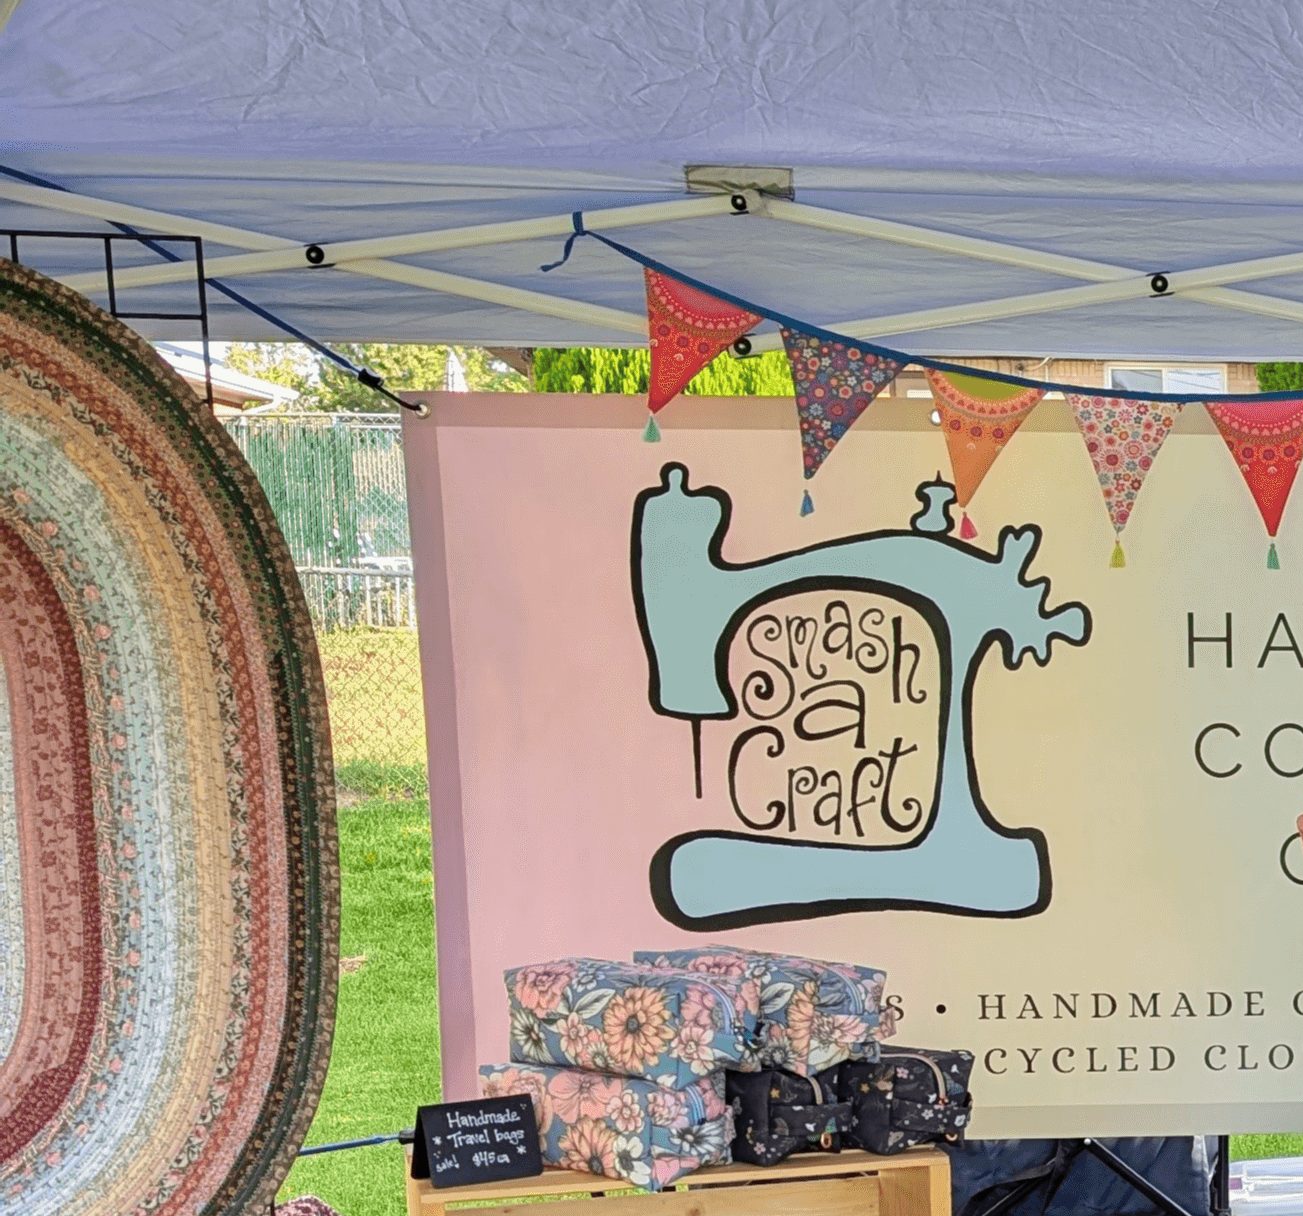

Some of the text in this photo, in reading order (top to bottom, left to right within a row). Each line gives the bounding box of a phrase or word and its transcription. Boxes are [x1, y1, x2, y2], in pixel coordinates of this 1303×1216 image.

[741, 599, 928, 721] Smash
[793, 679, 866, 749] a
[727, 725, 923, 837] Craft
[977, 990, 1265, 1020] HANDMADE
[951, 1043, 1176, 1075] CYCLED
[446, 1108, 521, 1129] Handmade
[446, 1128, 525, 1148] Travel bags
[472, 1151, 496, 1168] $45
